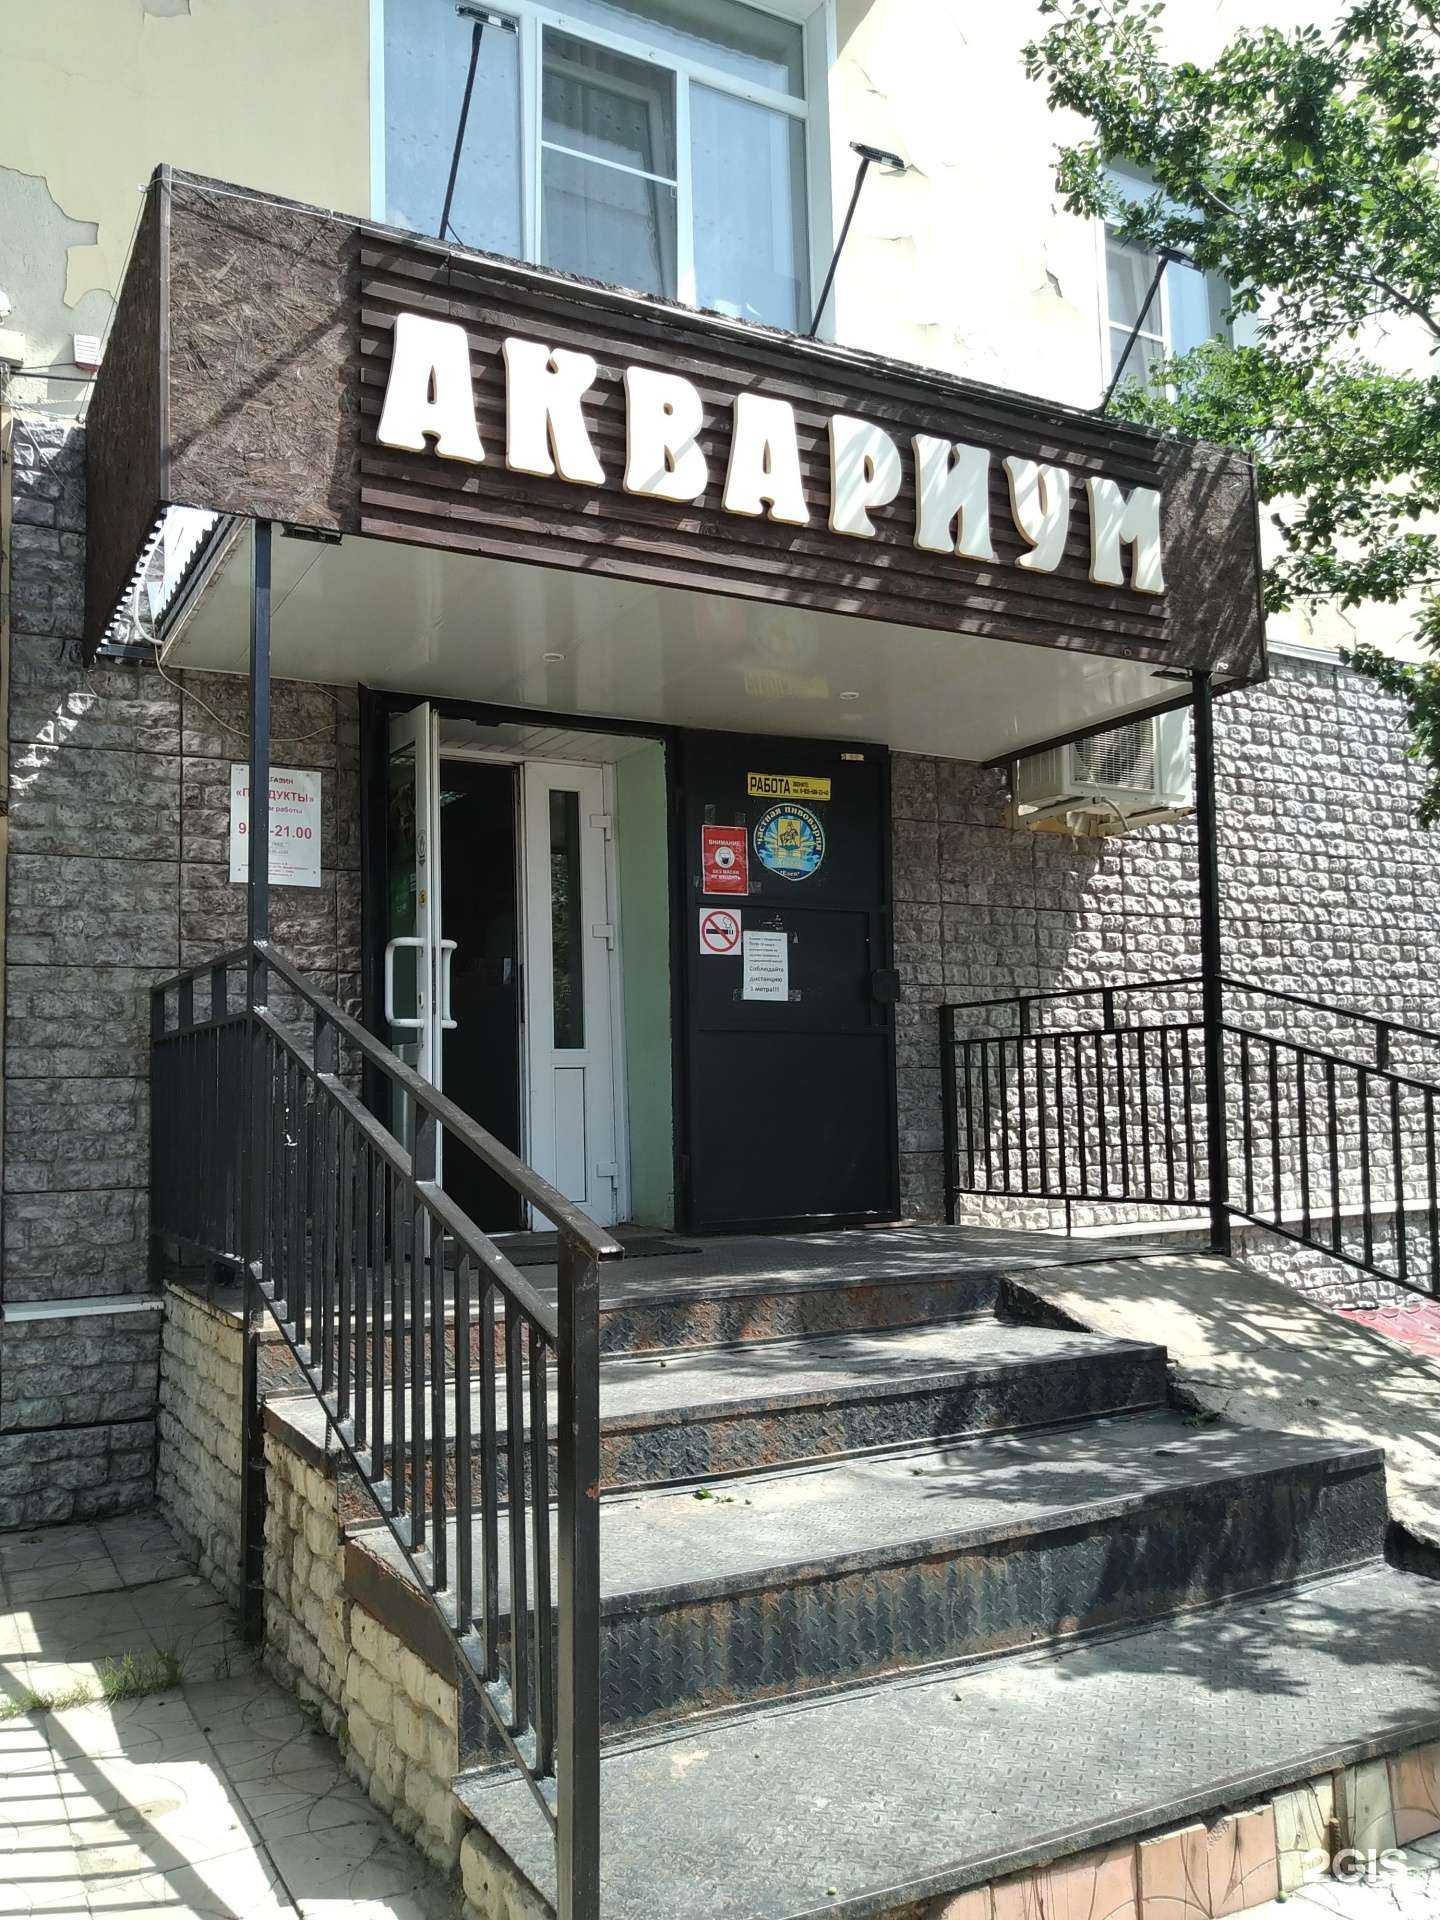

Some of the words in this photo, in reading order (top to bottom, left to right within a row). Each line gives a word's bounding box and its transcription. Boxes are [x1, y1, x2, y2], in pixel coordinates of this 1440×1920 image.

[375, 312, 1166, 595] АКВАРИУМ
[750, 776, 791, 794] РАБОТА
[236, 787, 314, 803] «ПДУКТЫ»
